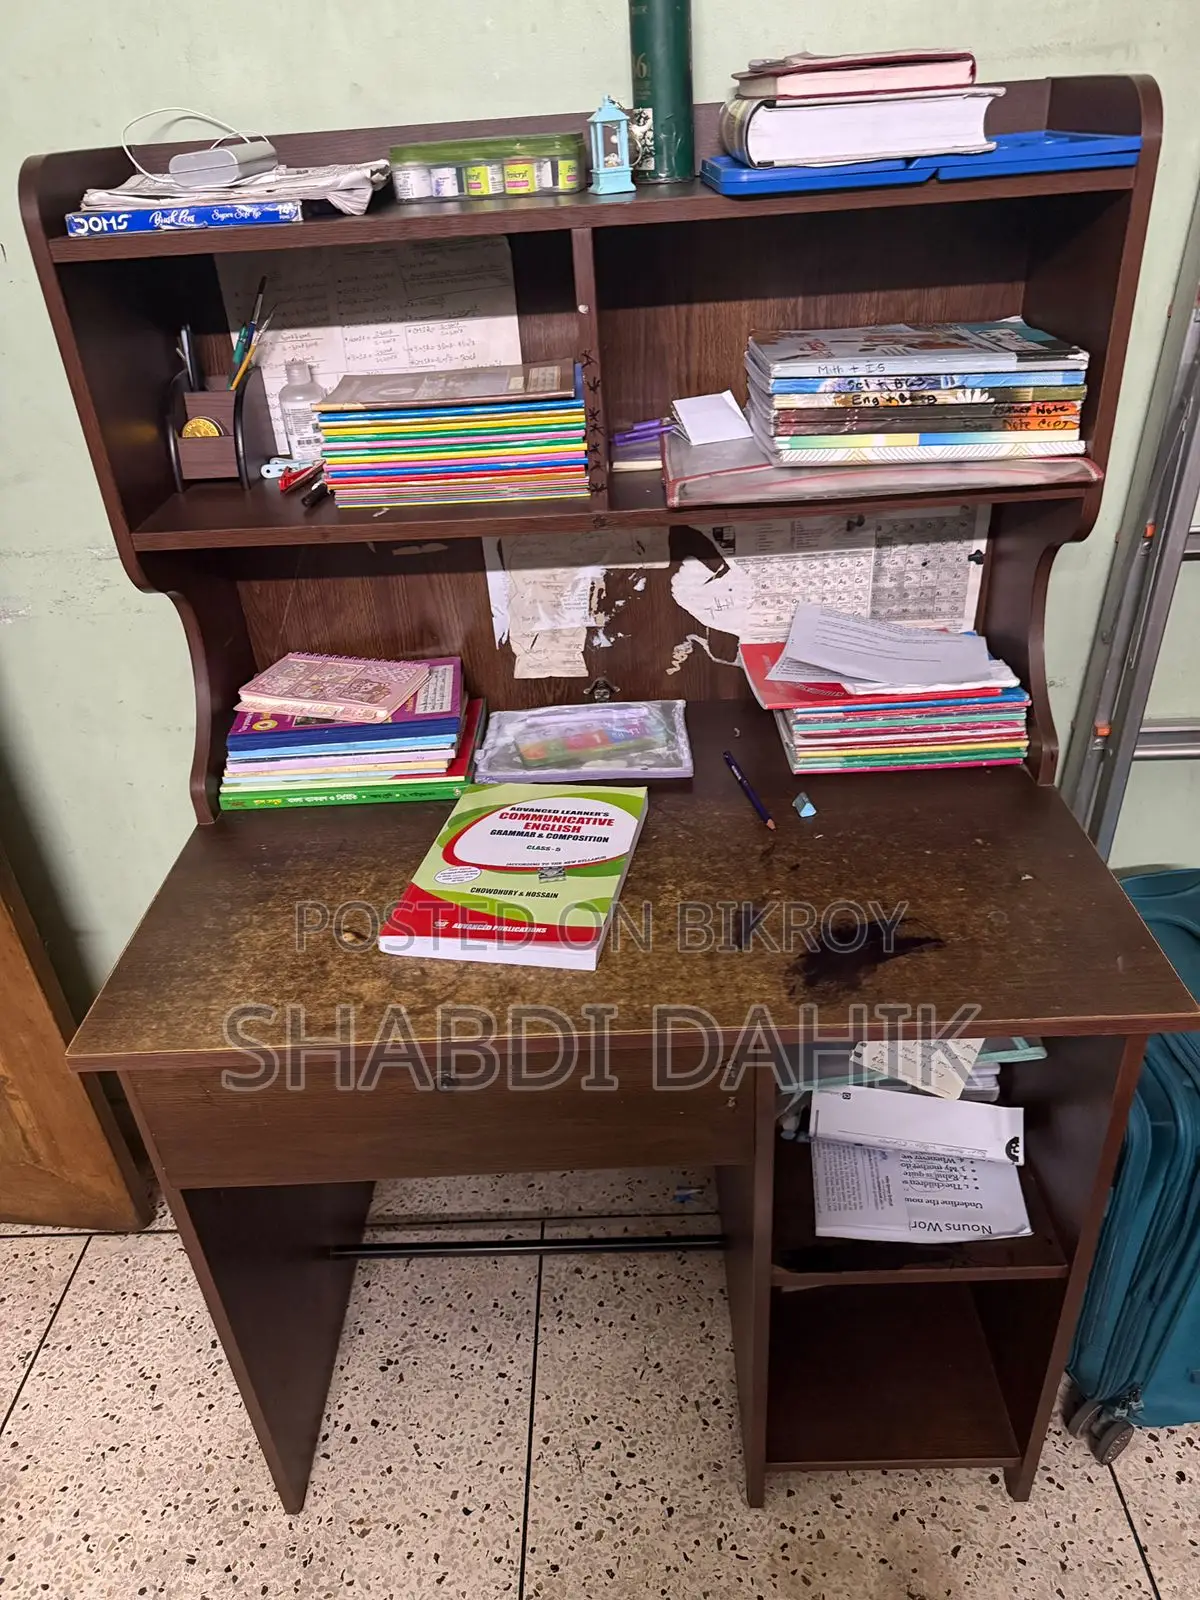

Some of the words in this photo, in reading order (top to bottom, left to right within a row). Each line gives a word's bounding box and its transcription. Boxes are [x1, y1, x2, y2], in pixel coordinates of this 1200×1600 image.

[73, 213, 129, 234] DOMS
[510, 806, 560, 814] ADVANCED
[560, 809, 610, 817] LEARNER'S
[499, 812, 615, 827] COMMUNICATIVE
[523, 822, 582, 834] ENGLISH
[490, 829, 537, 839] GRAMMAR
[545, 833, 609, 843] COMPOSITION
[526, 844, 551, 852] CLASS
[470, 887, 518, 897] CHOWDHURY
[524, 891, 559, 899] HOSSAIN
[451, 922, 492, 931] ADVANCED
[492, 925, 548, 933] PUBLICATIONS
[903, 1171, 926, 1179] quite
[910, 1180, 946, 1189] children
[941, 1201, 983, 1209] Underline
[911, 1221, 943, 1232] Wor
[945, 1222, 993, 1235] Nouns
